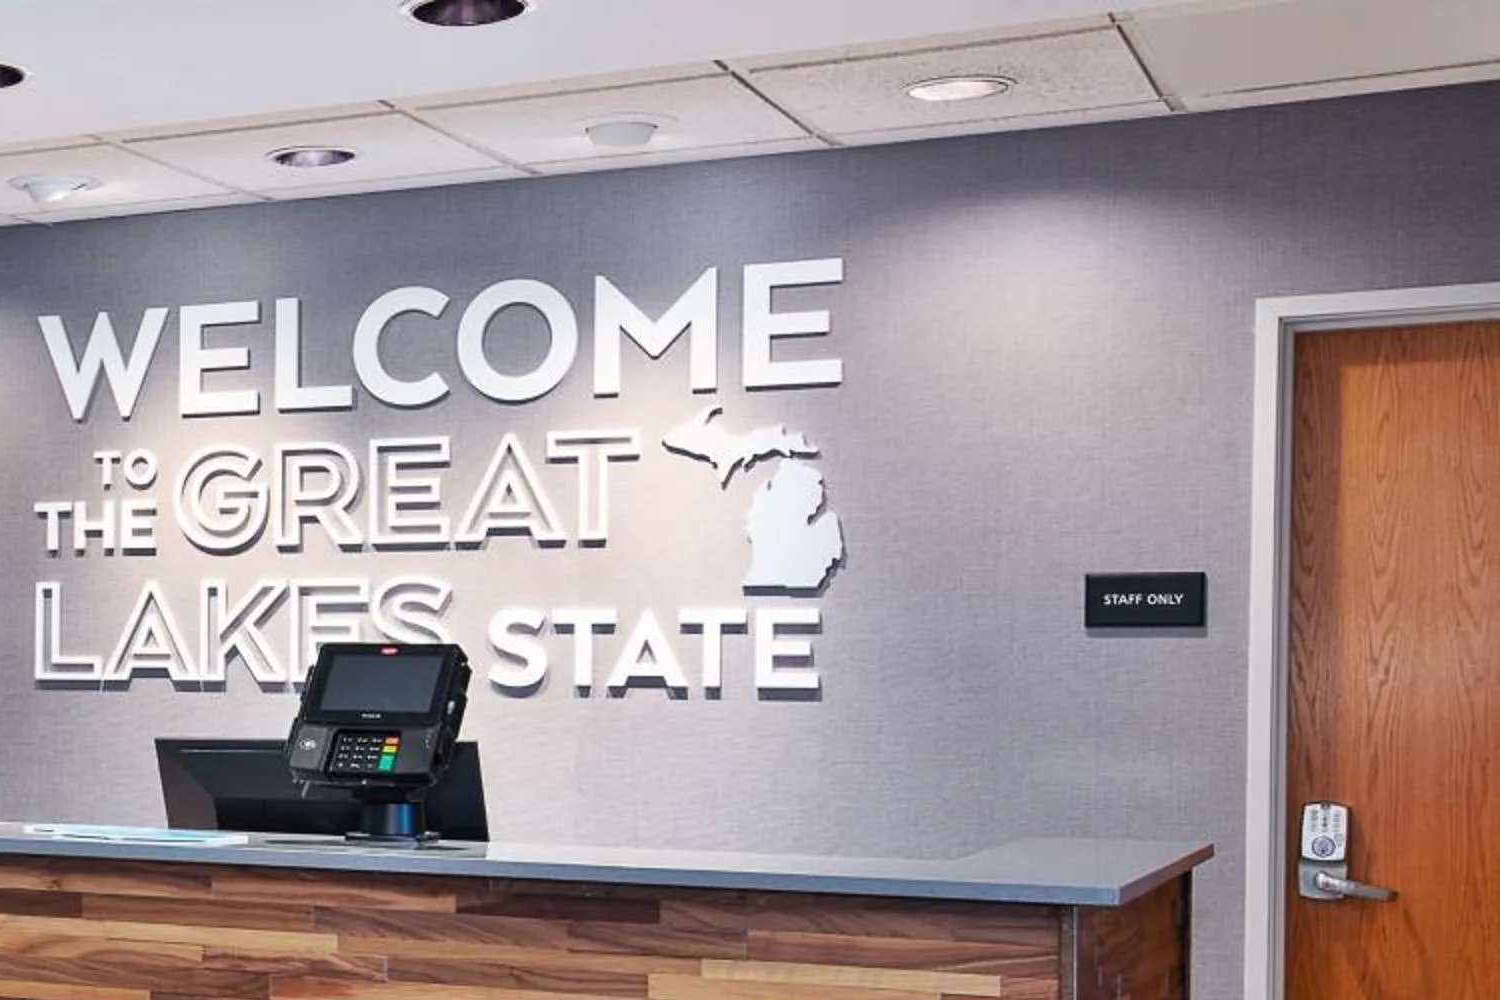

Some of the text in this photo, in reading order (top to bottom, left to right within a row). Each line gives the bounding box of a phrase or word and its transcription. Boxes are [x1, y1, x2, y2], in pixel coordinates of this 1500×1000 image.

[37, 257, 844, 422] WELCOME
[34, 427, 642, 556] THE GREAT
[94, 450, 157, 491] TO
[1103, 592, 1184, 606] STAFF ONLY
[487, 606, 822, 699] STATE
